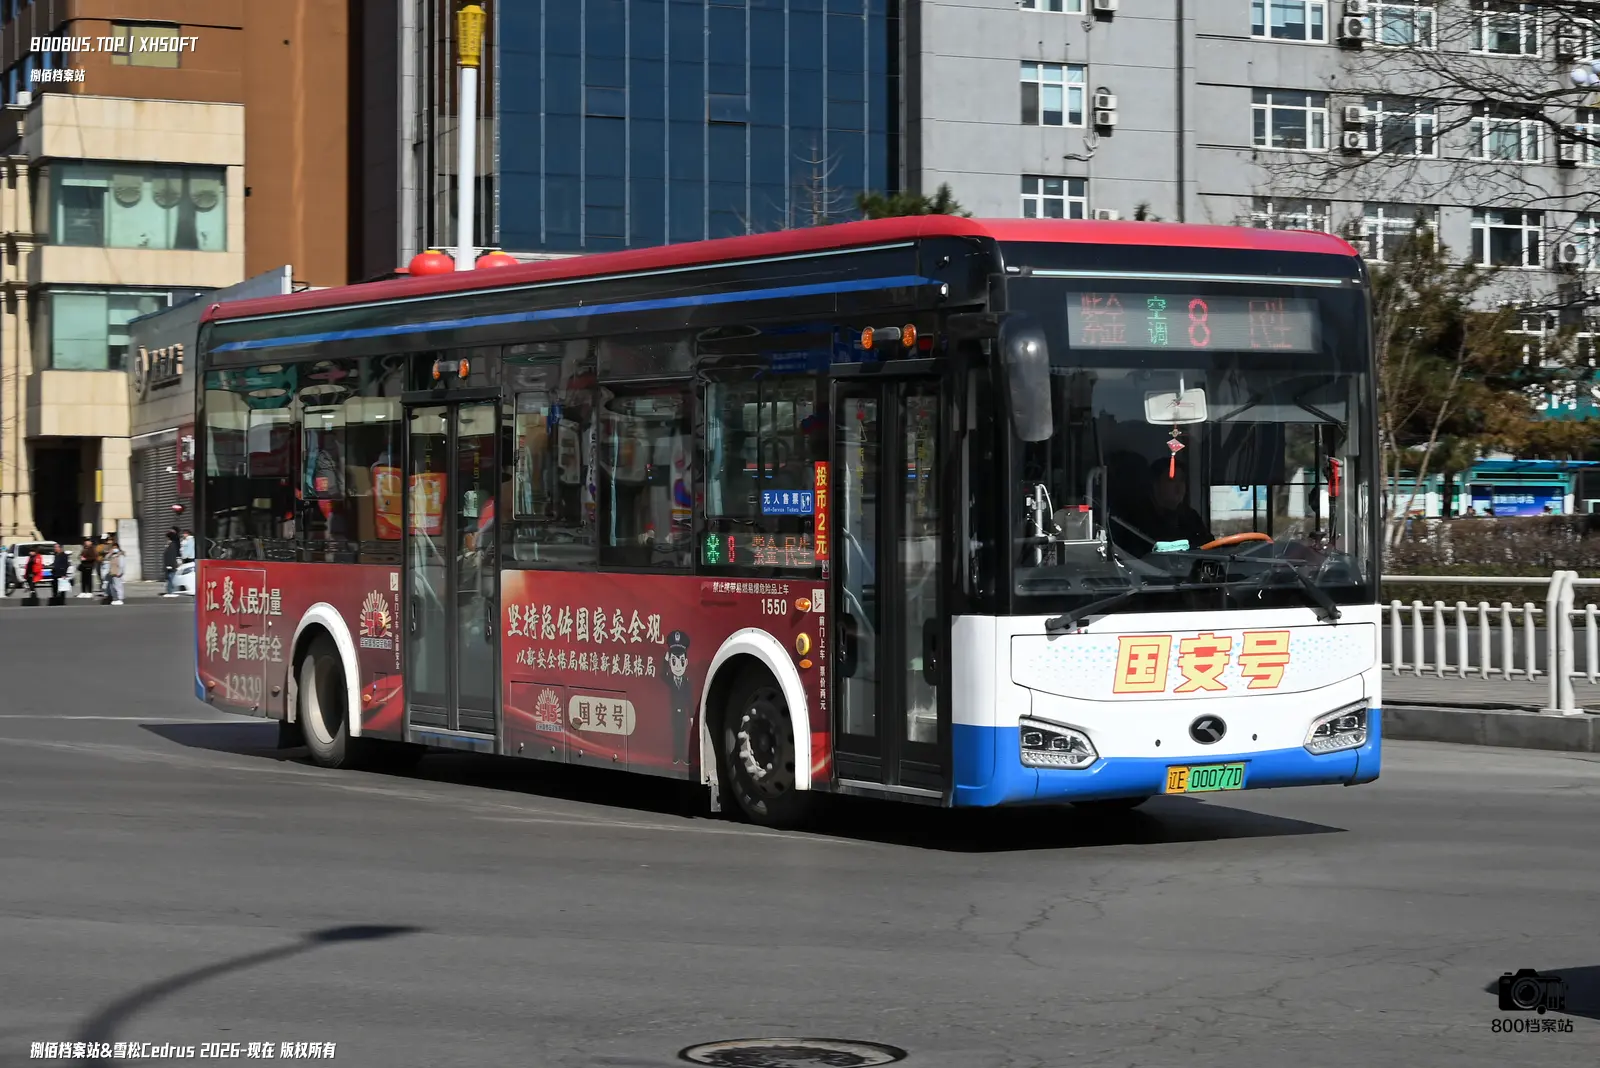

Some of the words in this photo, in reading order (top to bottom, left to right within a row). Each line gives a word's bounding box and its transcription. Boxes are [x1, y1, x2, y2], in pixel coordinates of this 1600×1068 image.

[1147, 295, 1168, 346] 空调
[1188, 297, 1211, 347] 8
[763, 492, 799, 505] 无人售票
[816, 465, 828, 555] 投币2元
[205, 575, 282, 617] 汇聚人民力量
[712, 581, 790, 596] 禁止携带易燃易爆危险品上车
[761, 598, 787, 615] 1550
[205, 620, 283, 663] 维护国家安全
[507, 602, 666, 645] 坚持总体国家安全观
[818, 616, 826, 660] 前门上车
[516, 646, 656, 678] 以新安全格局保障新发展格局
[1112, 630, 1290, 693] 国安号
[224, 672, 262, 703] 12339
[578, 701, 624, 730] 国安号
[1191, 767, 1242, 788] 00077D
